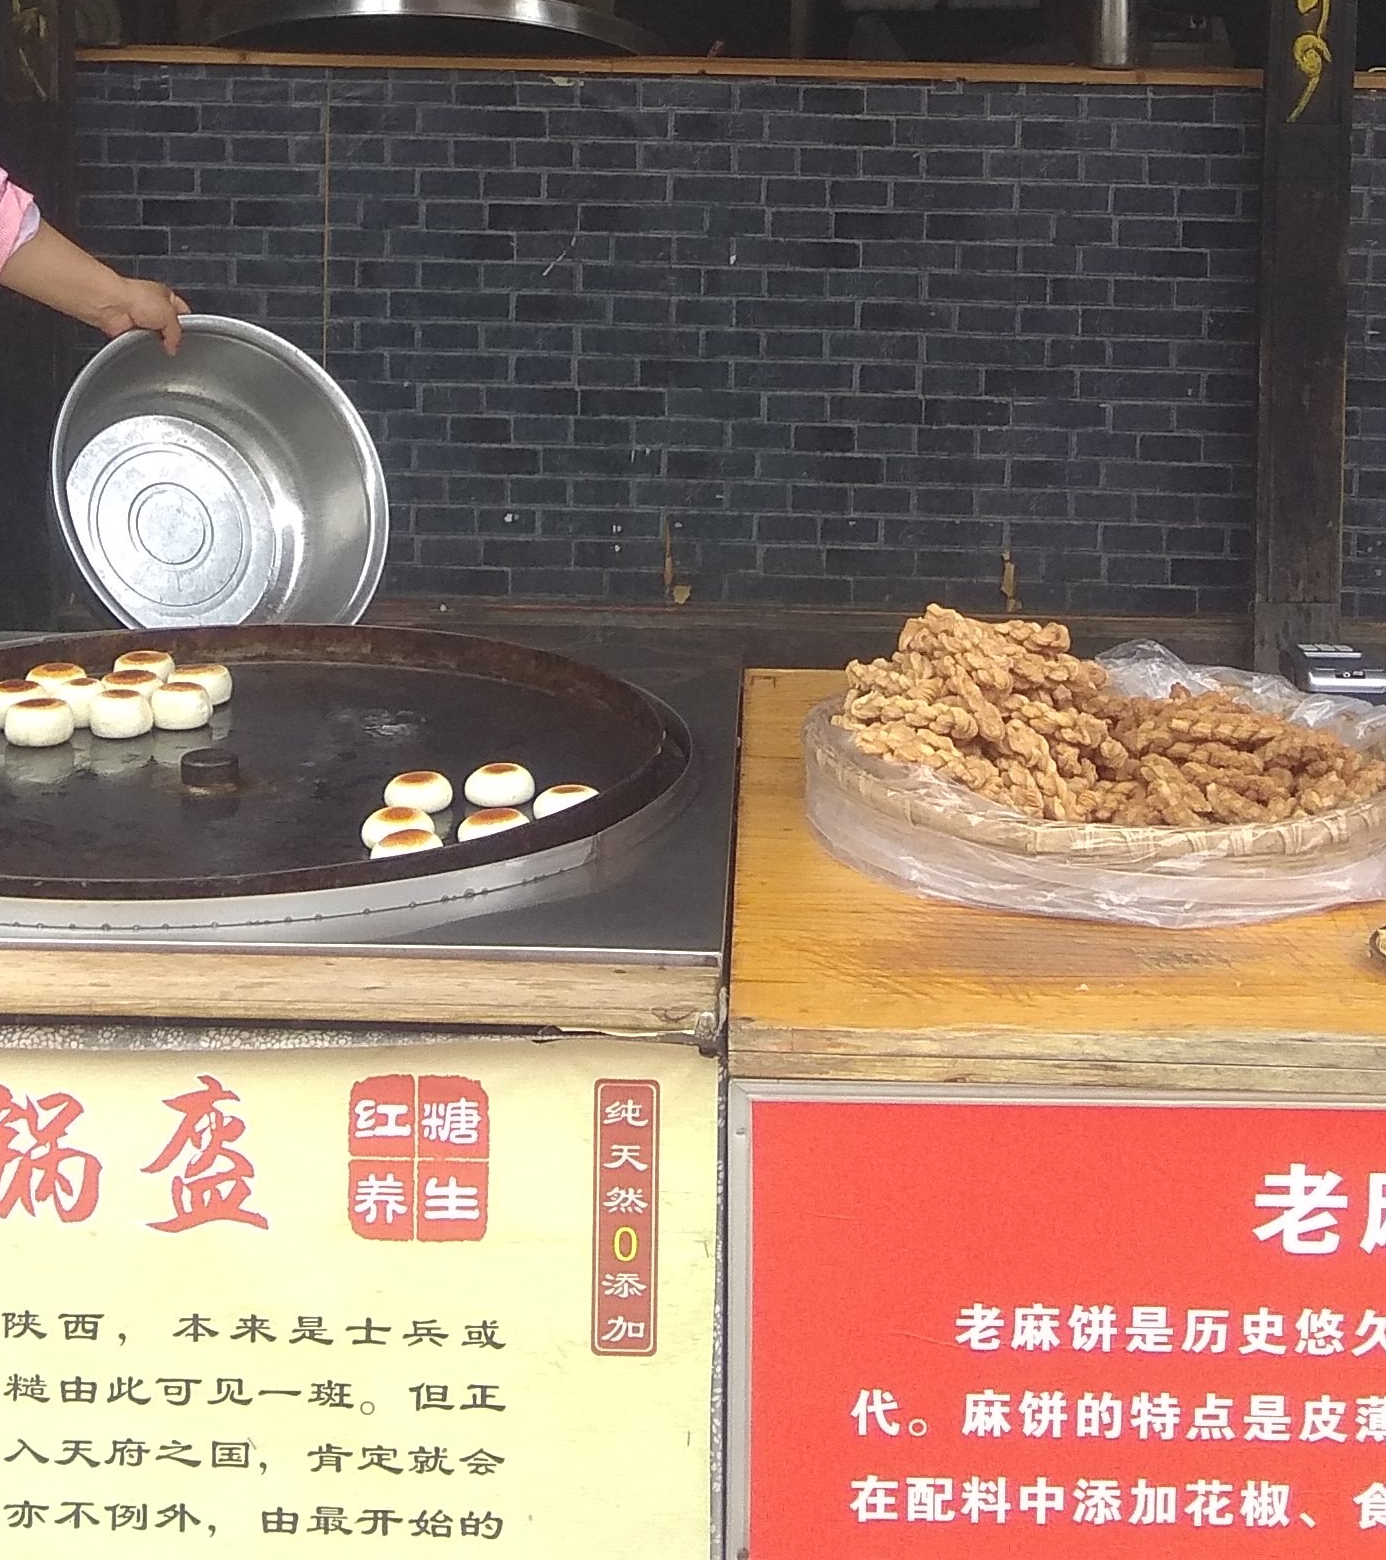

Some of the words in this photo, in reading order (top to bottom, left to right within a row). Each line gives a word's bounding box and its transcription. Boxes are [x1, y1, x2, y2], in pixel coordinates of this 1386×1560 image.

[601, 1099, 648, 1345] 纯天然0添加
